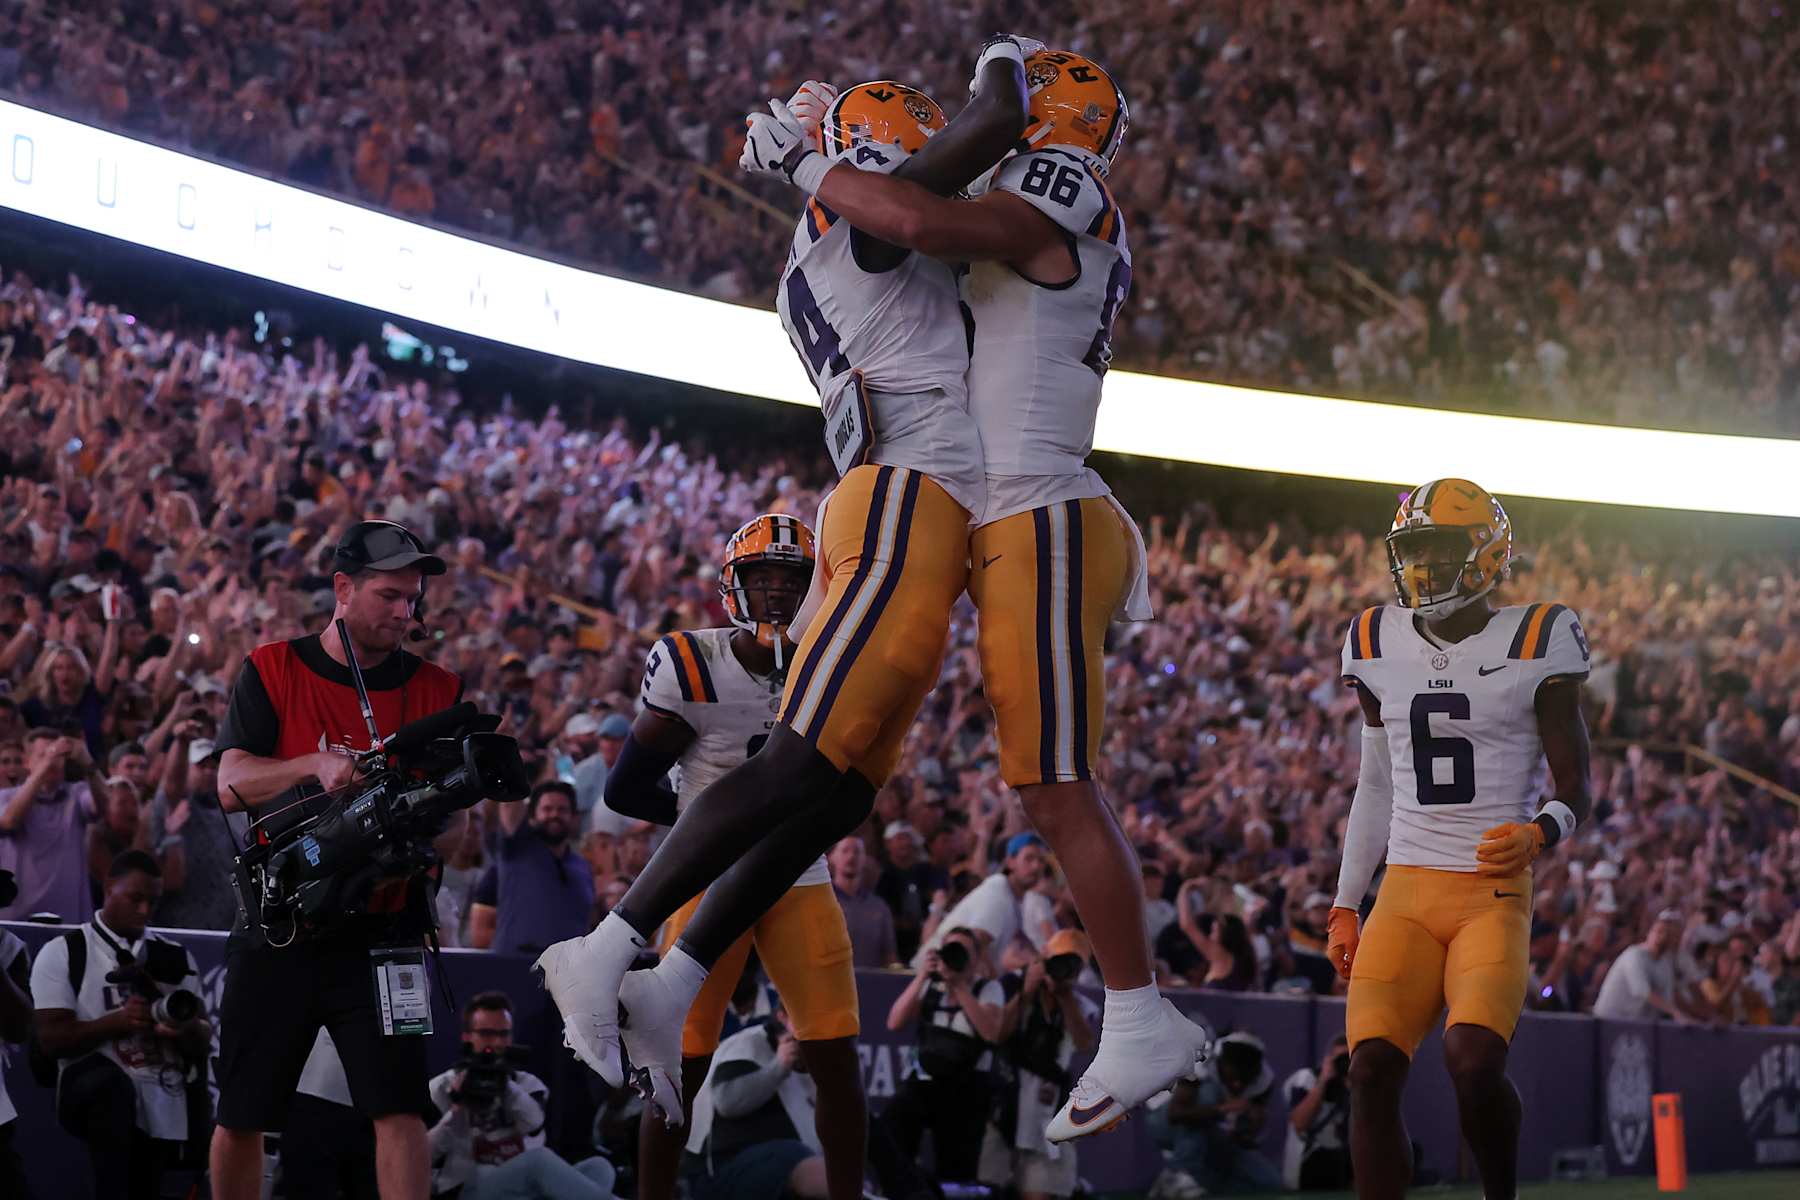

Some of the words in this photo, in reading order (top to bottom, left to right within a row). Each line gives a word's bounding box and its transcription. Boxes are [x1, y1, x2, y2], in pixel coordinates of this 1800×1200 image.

[1020, 157, 1083, 208] 86
[786, 264, 852, 377] 4
[1428, 679, 1453, 689] LSU
[1410, 692, 1476, 806] 6
